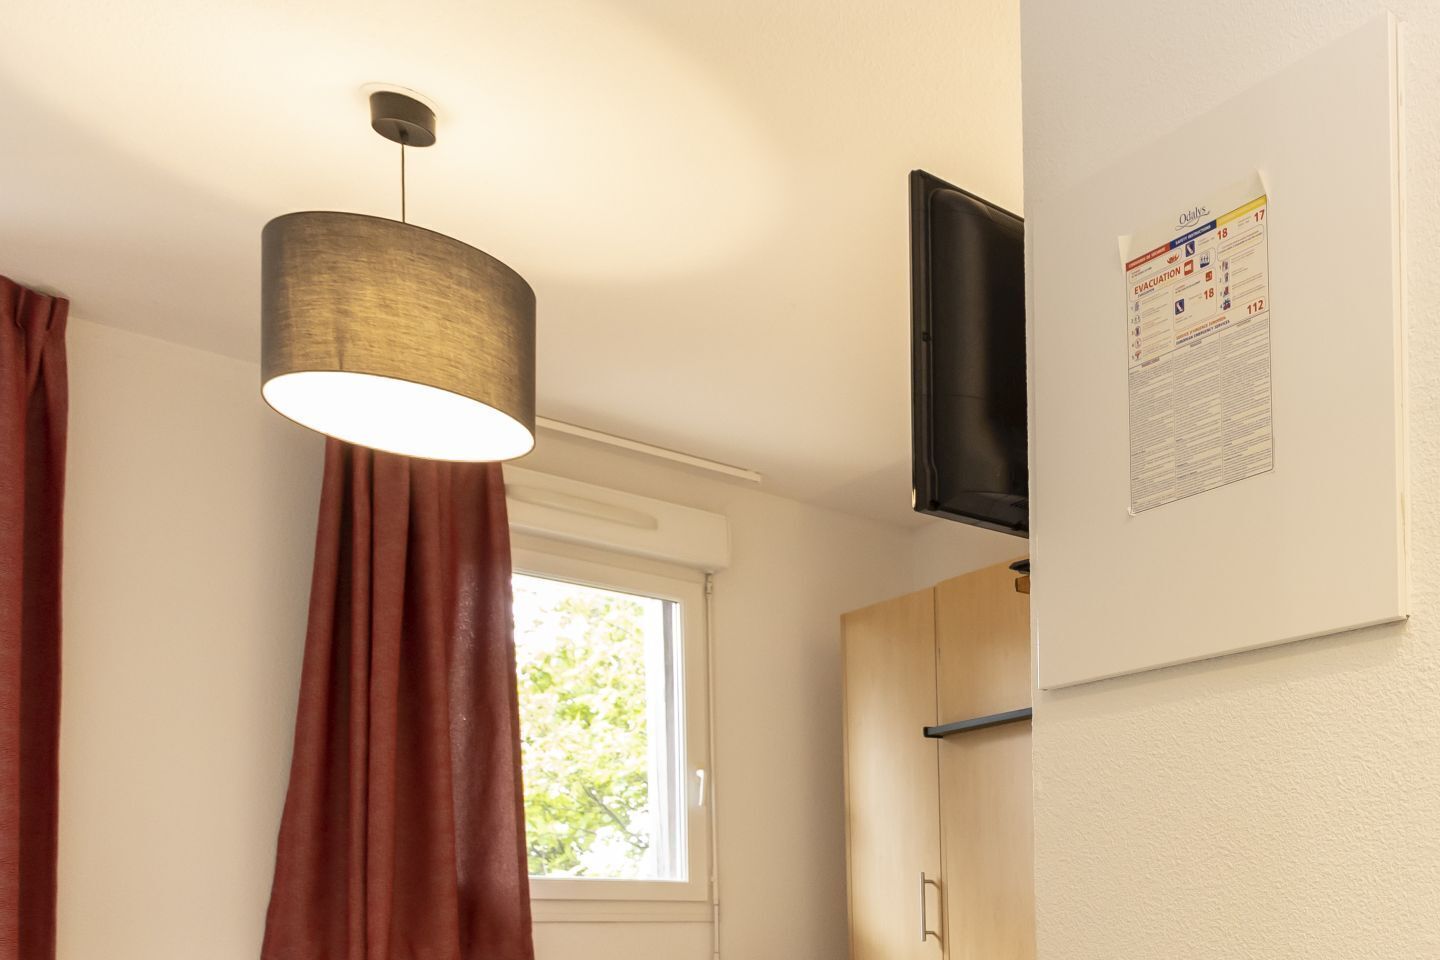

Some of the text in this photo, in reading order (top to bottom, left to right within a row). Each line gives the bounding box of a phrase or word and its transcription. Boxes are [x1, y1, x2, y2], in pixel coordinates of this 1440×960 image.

[1178, 206, 1208, 226] Odalys
[1254, 209, 1265, 222] 17
[1217, 228, 1228, 239] 18
[1134, 266, 1181, 293] EVACUATION
[1204, 288, 1214, 300] 18
[1247, 300, 1264, 314] 112
